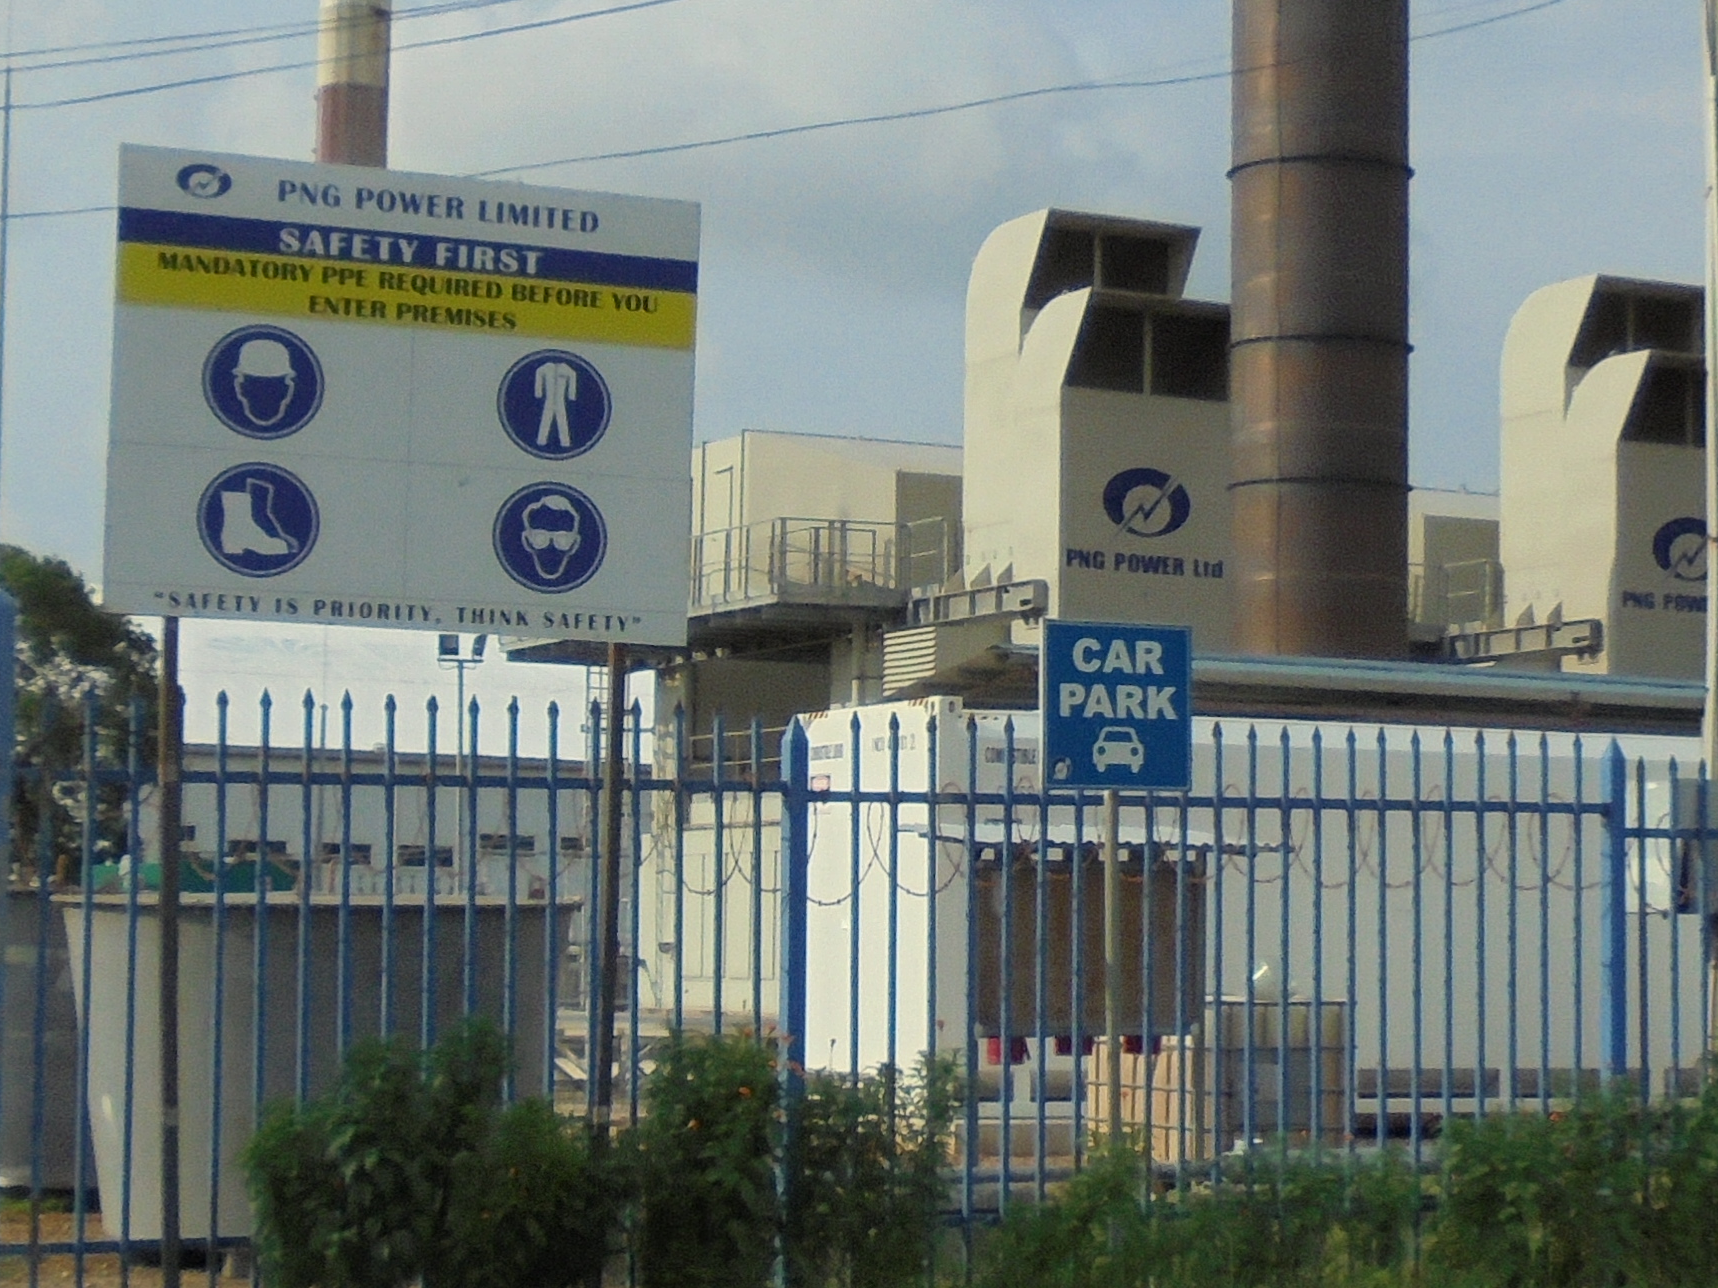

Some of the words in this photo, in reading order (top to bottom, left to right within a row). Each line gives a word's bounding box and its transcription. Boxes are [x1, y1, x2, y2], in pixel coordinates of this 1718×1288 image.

[277, 179, 341, 208] PNG
[355, 187, 465, 221] POWER
[478, 199, 599, 233] LIMITED
[279, 228, 419, 263] SAFETY
[435, 241, 545, 275] FIRST
[158, 252, 314, 283] MANDATORY
[321, 266, 367, 287] PPE
[379, 271, 503, 299] REQUIRED
[511, 283, 604, 308] BEFORE
[611, 291, 658, 313] YOU
[309, 295, 387, 318] ENTER
[396, 302, 517, 330] PREMISES
[1066, 548, 1106, 570] PNG
[1114, 553, 1185, 576] POWER
[274, 597, 299, 616] IS
[455, 606, 530, 627] THINK
[1073, 637, 1164, 675] CAR
[1059, 682, 1179, 720] PARK
